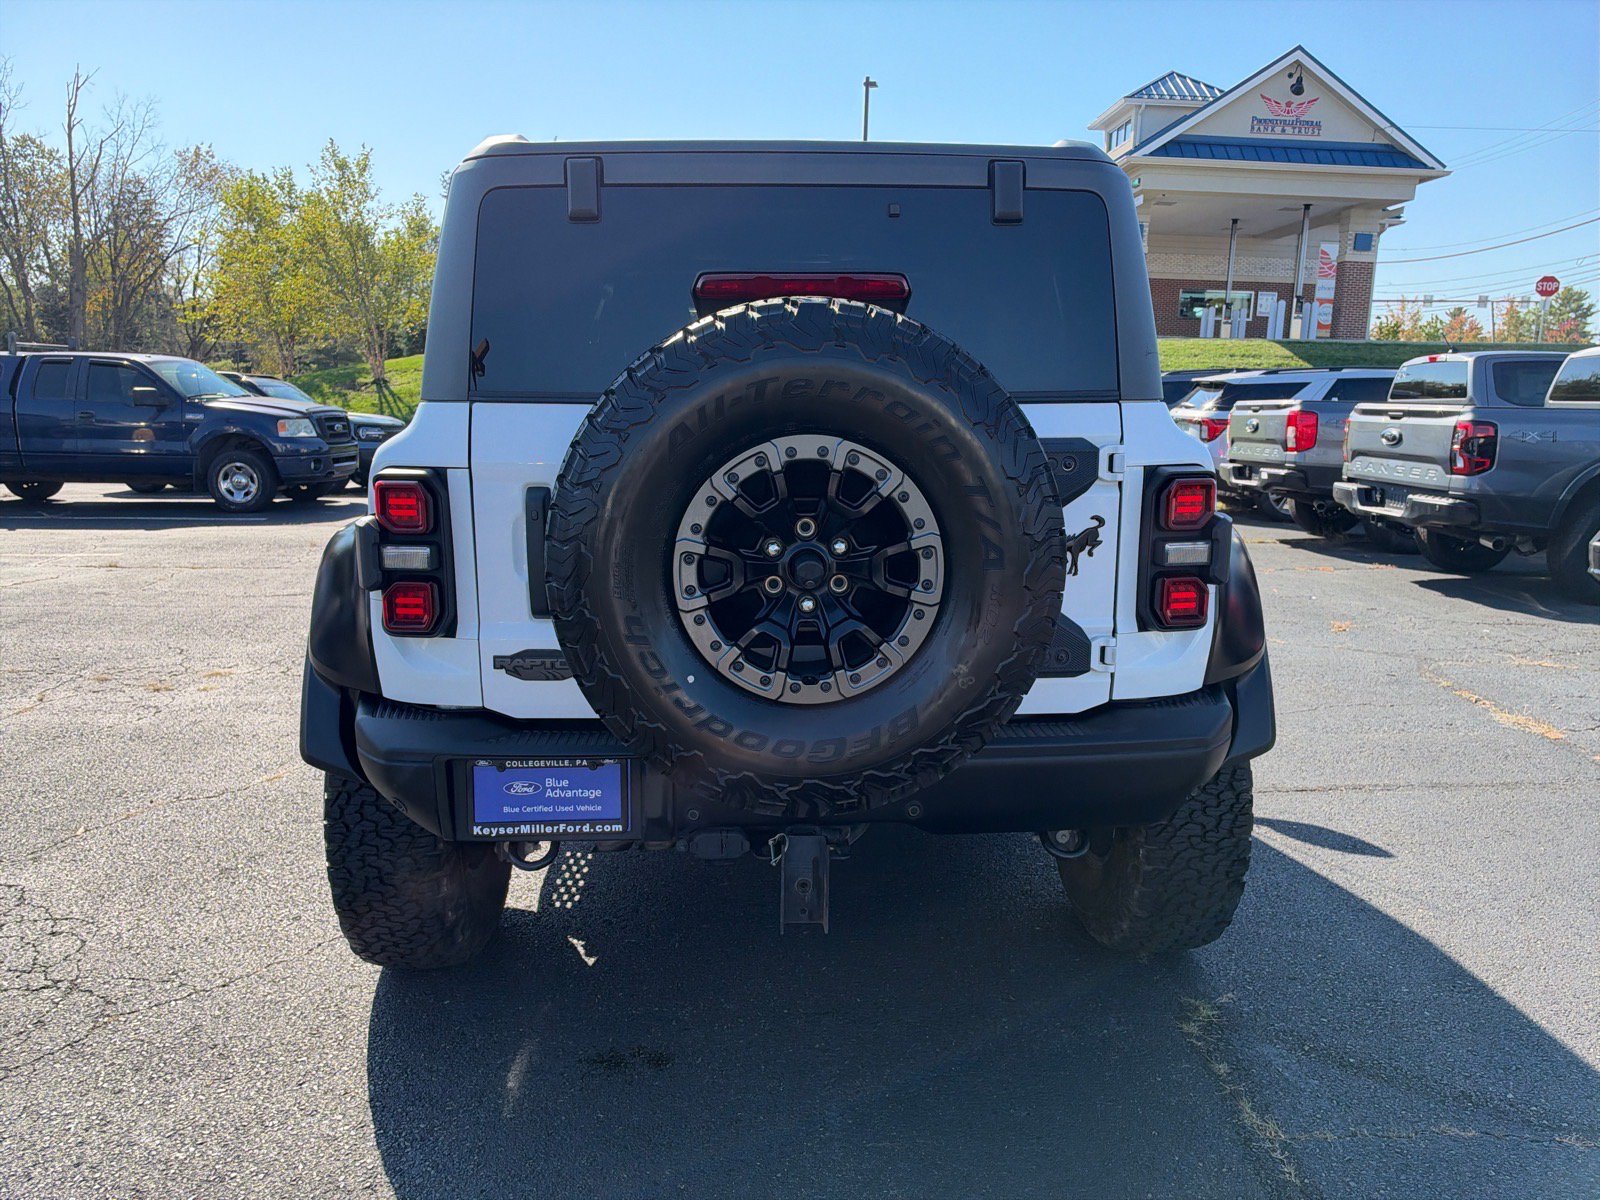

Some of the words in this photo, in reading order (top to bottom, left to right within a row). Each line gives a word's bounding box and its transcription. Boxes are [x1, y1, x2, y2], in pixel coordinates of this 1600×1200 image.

[1292, 126, 1321, 134] TRUST
[1537, 282, 1558, 291] STOP
[666, 376, 963, 463] All-Terrain
[1352, 461, 1438, 480] RANGER
[624, 613, 920, 763] BFGoodrich
[505, 759, 573, 768] COLLEGEVILLE,
[575, 759, 588, 767] PA
[509, 782, 535, 793] Ford
[545, 777, 569, 788] Blue
[545, 788, 602, 799] Advantage
[521, 804, 553, 813] Certified
[555, 804, 574, 812] Used
[575, 803, 602, 812] Vehicle
[473, 823, 623, 836] KeyserMillerFord.com
